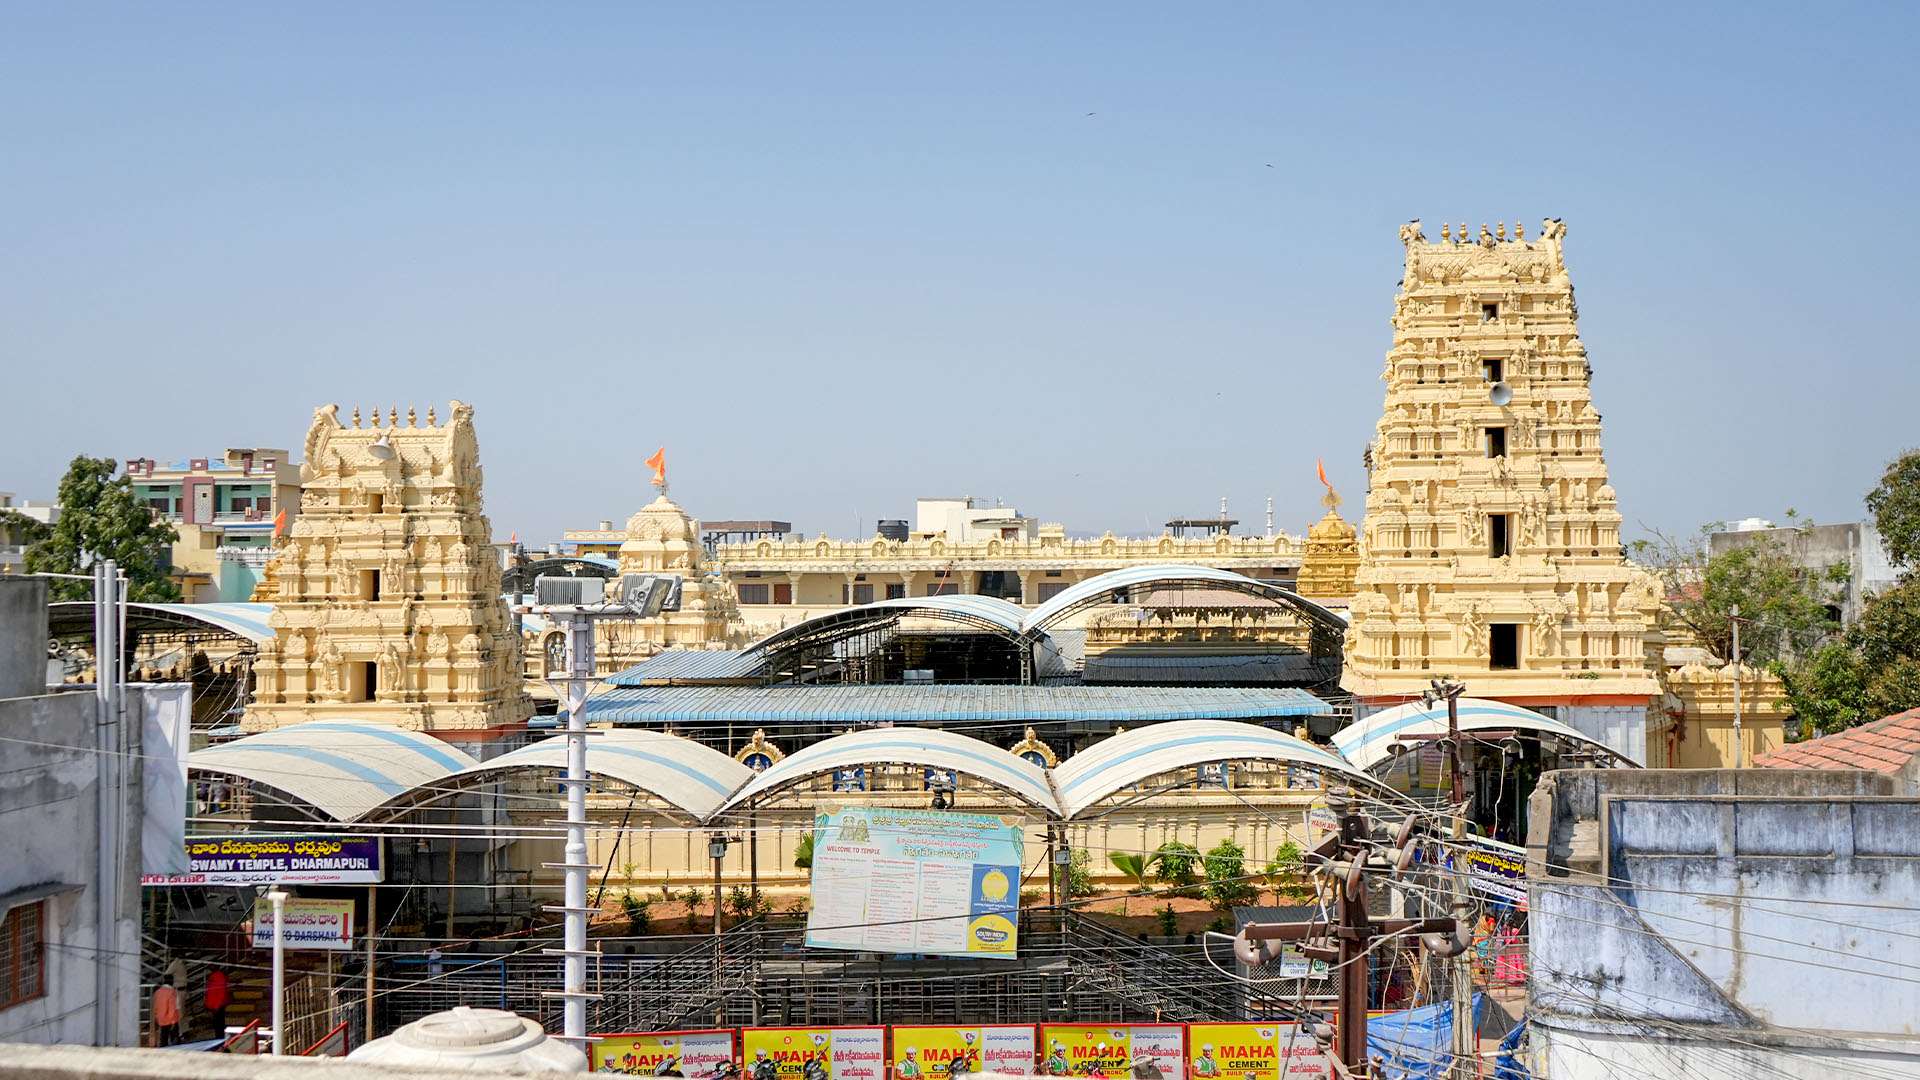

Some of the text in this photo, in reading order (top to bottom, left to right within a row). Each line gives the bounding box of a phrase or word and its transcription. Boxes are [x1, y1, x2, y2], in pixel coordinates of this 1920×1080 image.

[1312, 820, 1326, 828] WASH
[827, 845, 851, 853] WELCOME
[191, 858, 369, 872] SWAMY TEMPLE, DHARMAPURI
[257, 930, 274, 940] WA
[294, 930, 337, 942] DARSHAN
[773, 1050, 829, 1063] MAHA
[923, 1049, 979, 1062] MAHA
[1073, 1046, 1128, 1058] MAHA
[1220, 1046, 1276, 1058] MAHA
